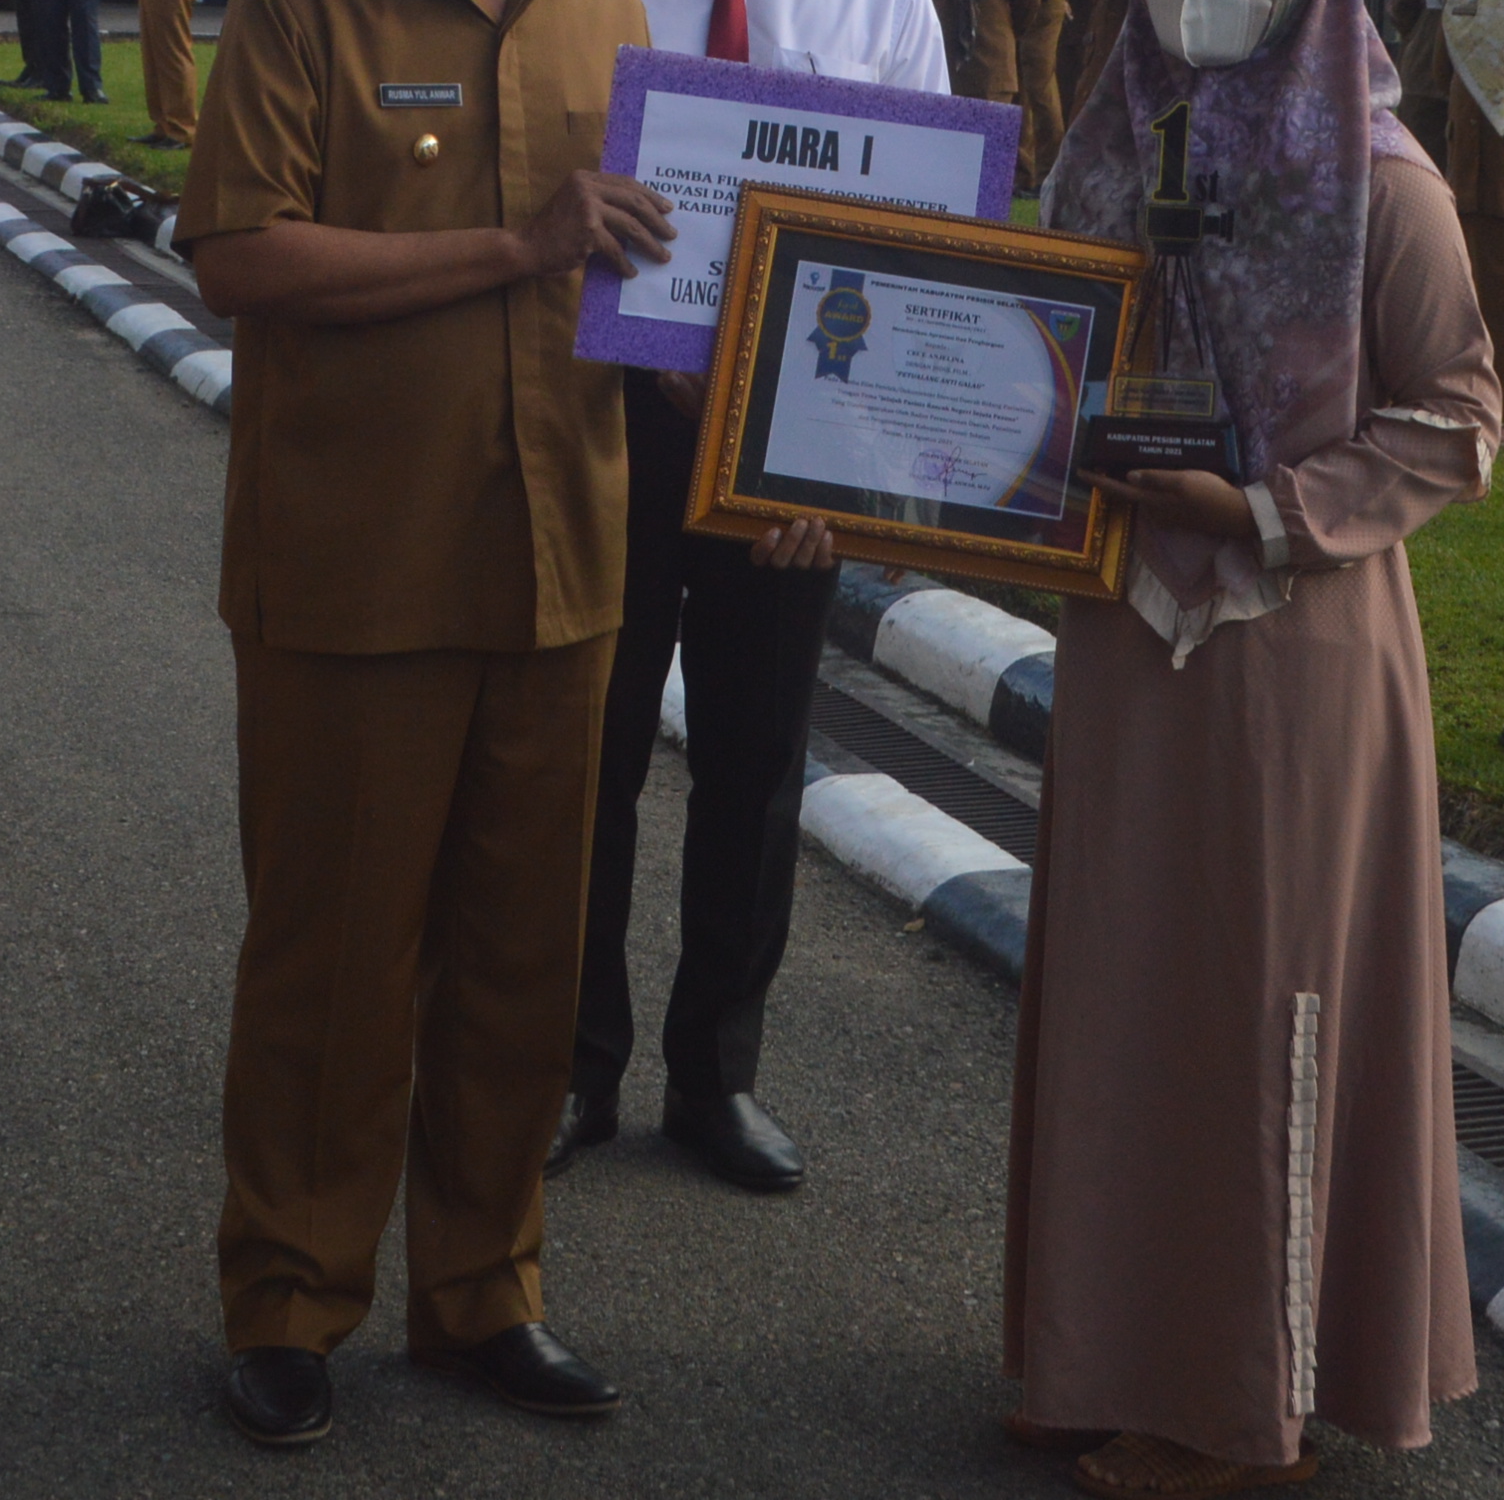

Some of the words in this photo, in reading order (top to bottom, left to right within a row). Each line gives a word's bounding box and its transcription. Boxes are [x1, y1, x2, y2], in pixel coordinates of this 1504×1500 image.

[742, 119, 840, 172] JUARA
[860, 135, 874, 176] I
[655, 166, 712, 184] LOMBA
[643, 180, 708, 198] INOVASI
[678, 200, 736, 217] KABUP
[670, 277, 719, 307] UANG
[905, 303, 981, 325] SERTIFIKAT
[1106, 432, 1150, 442] KABUPATEN
[1152, 435, 1181, 444] PESISIR
[1183, 437, 1216, 447] SELATAN
[1138, 445, 1163, 454] TAHUN
[1164, 447, 1182, 456] 2021
